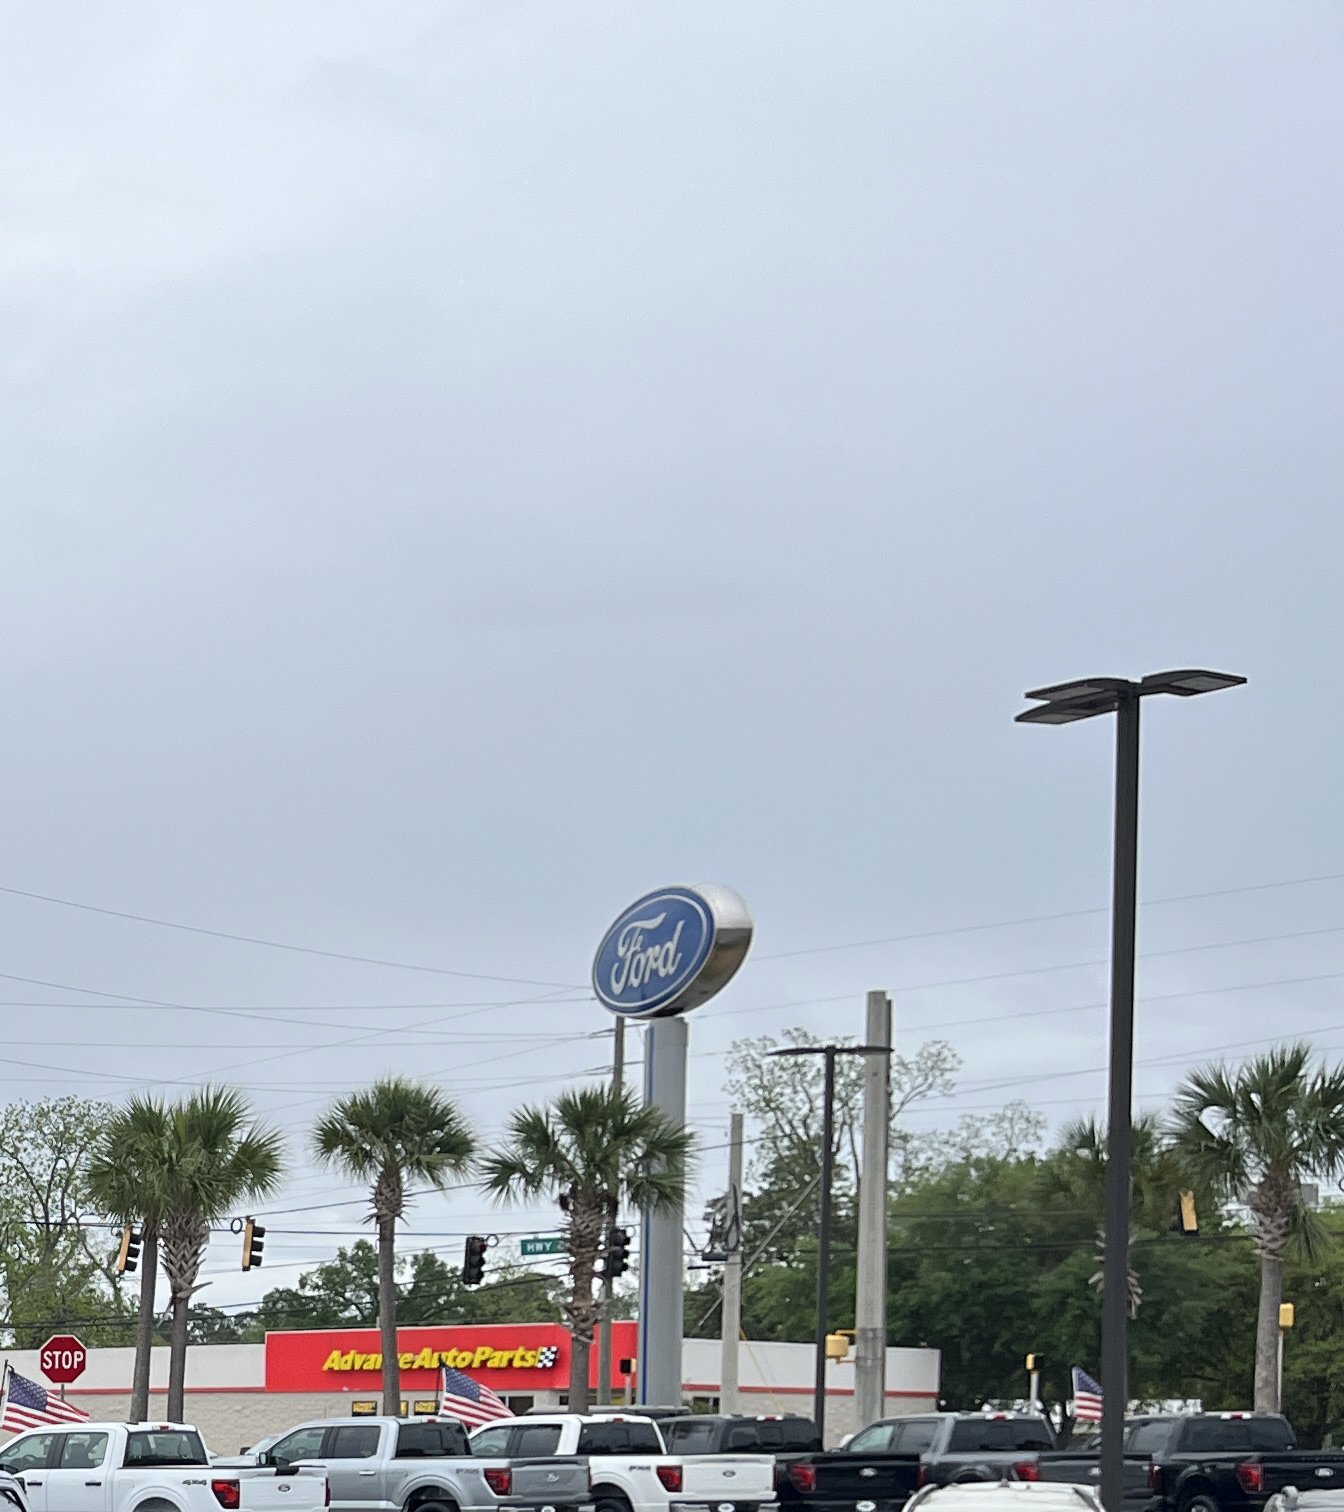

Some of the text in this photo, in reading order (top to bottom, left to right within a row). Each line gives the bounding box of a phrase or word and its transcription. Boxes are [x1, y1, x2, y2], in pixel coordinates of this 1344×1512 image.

[610, 912, 684, 995] Ford
[526, 1241, 552, 1252] HWY
[42, 1350, 84, 1370] STOP
[322, 1349, 414, 1371] Advae
[472, 1346, 537, 1369] Parts
